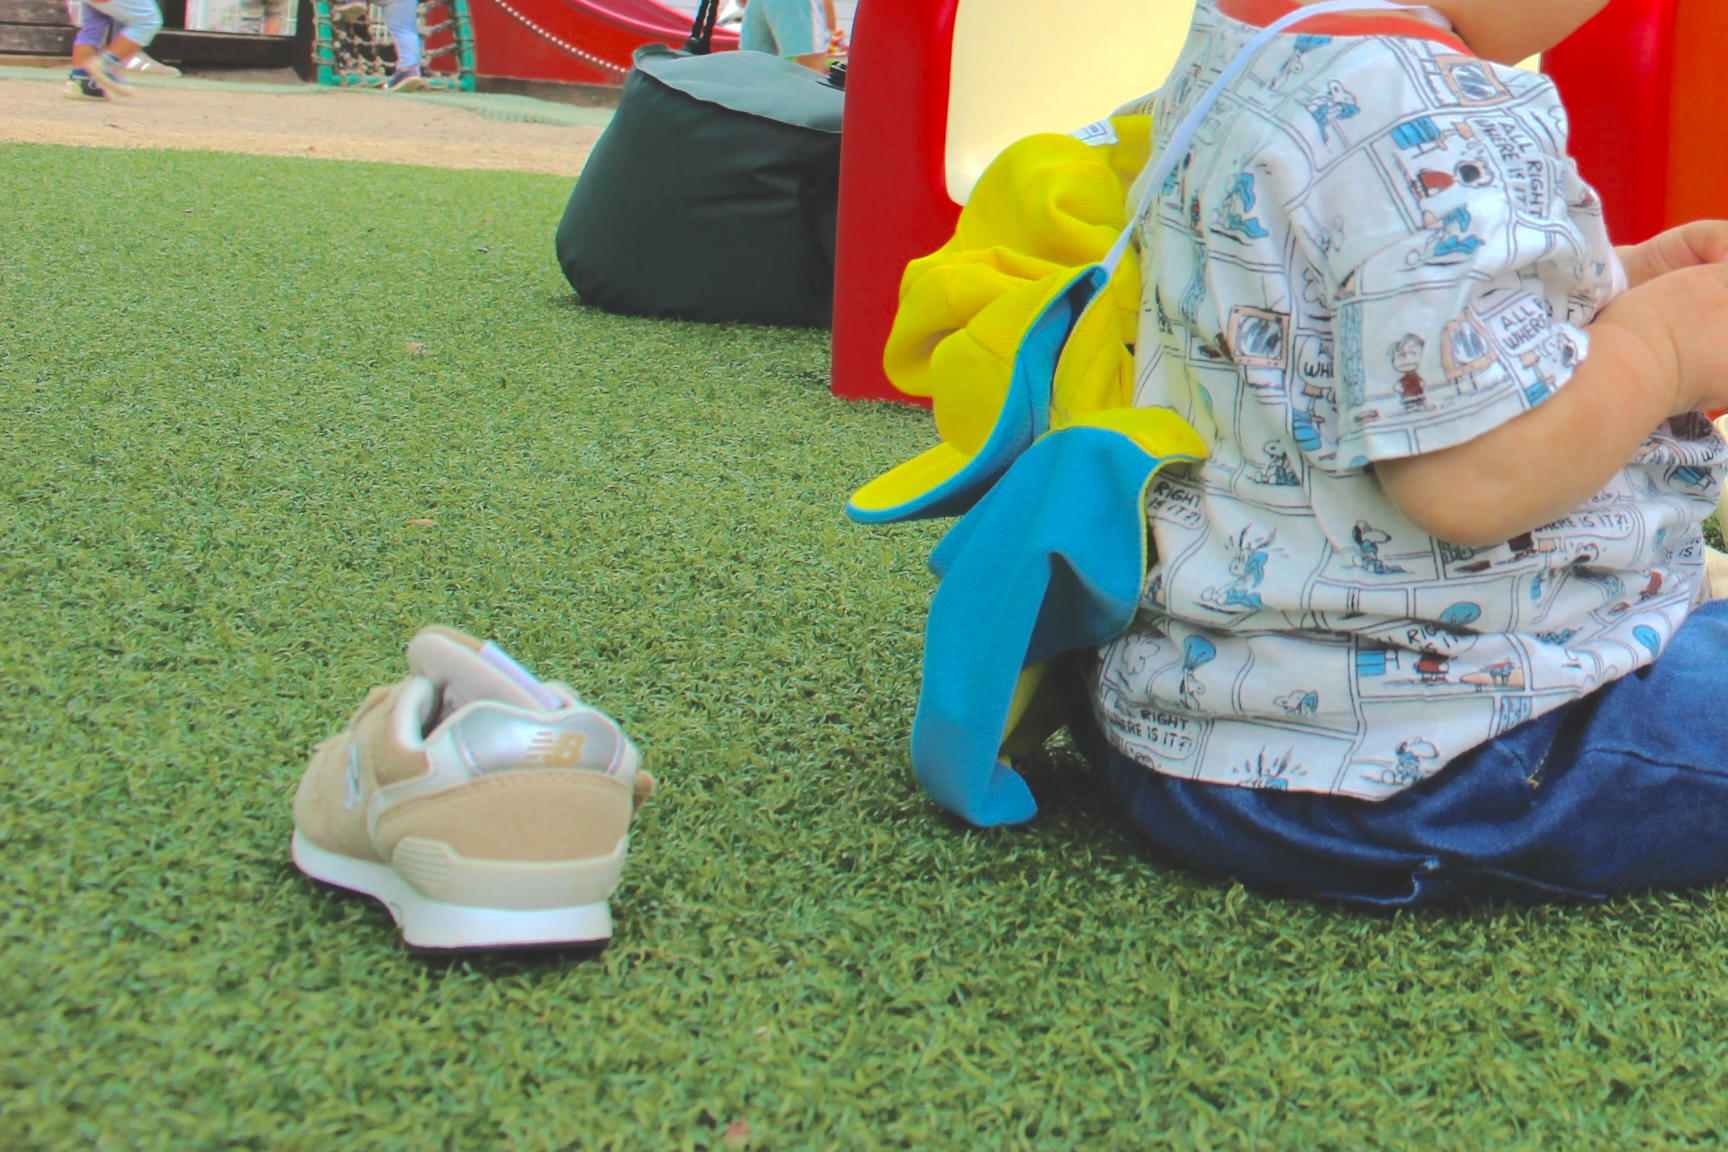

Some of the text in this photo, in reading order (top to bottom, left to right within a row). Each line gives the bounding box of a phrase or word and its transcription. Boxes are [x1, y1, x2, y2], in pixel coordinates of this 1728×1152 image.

[1497, 121, 1544, 219] ALL RIGHT
[1501, 305, 1537, 331] ALL
[1153, 480, 1201, 508] RIGHT
[1578, 515, 1595, 528] IS
[1140, 709, 1189, 730] RIGHT
[1146, 725, 1159, 742] IS
